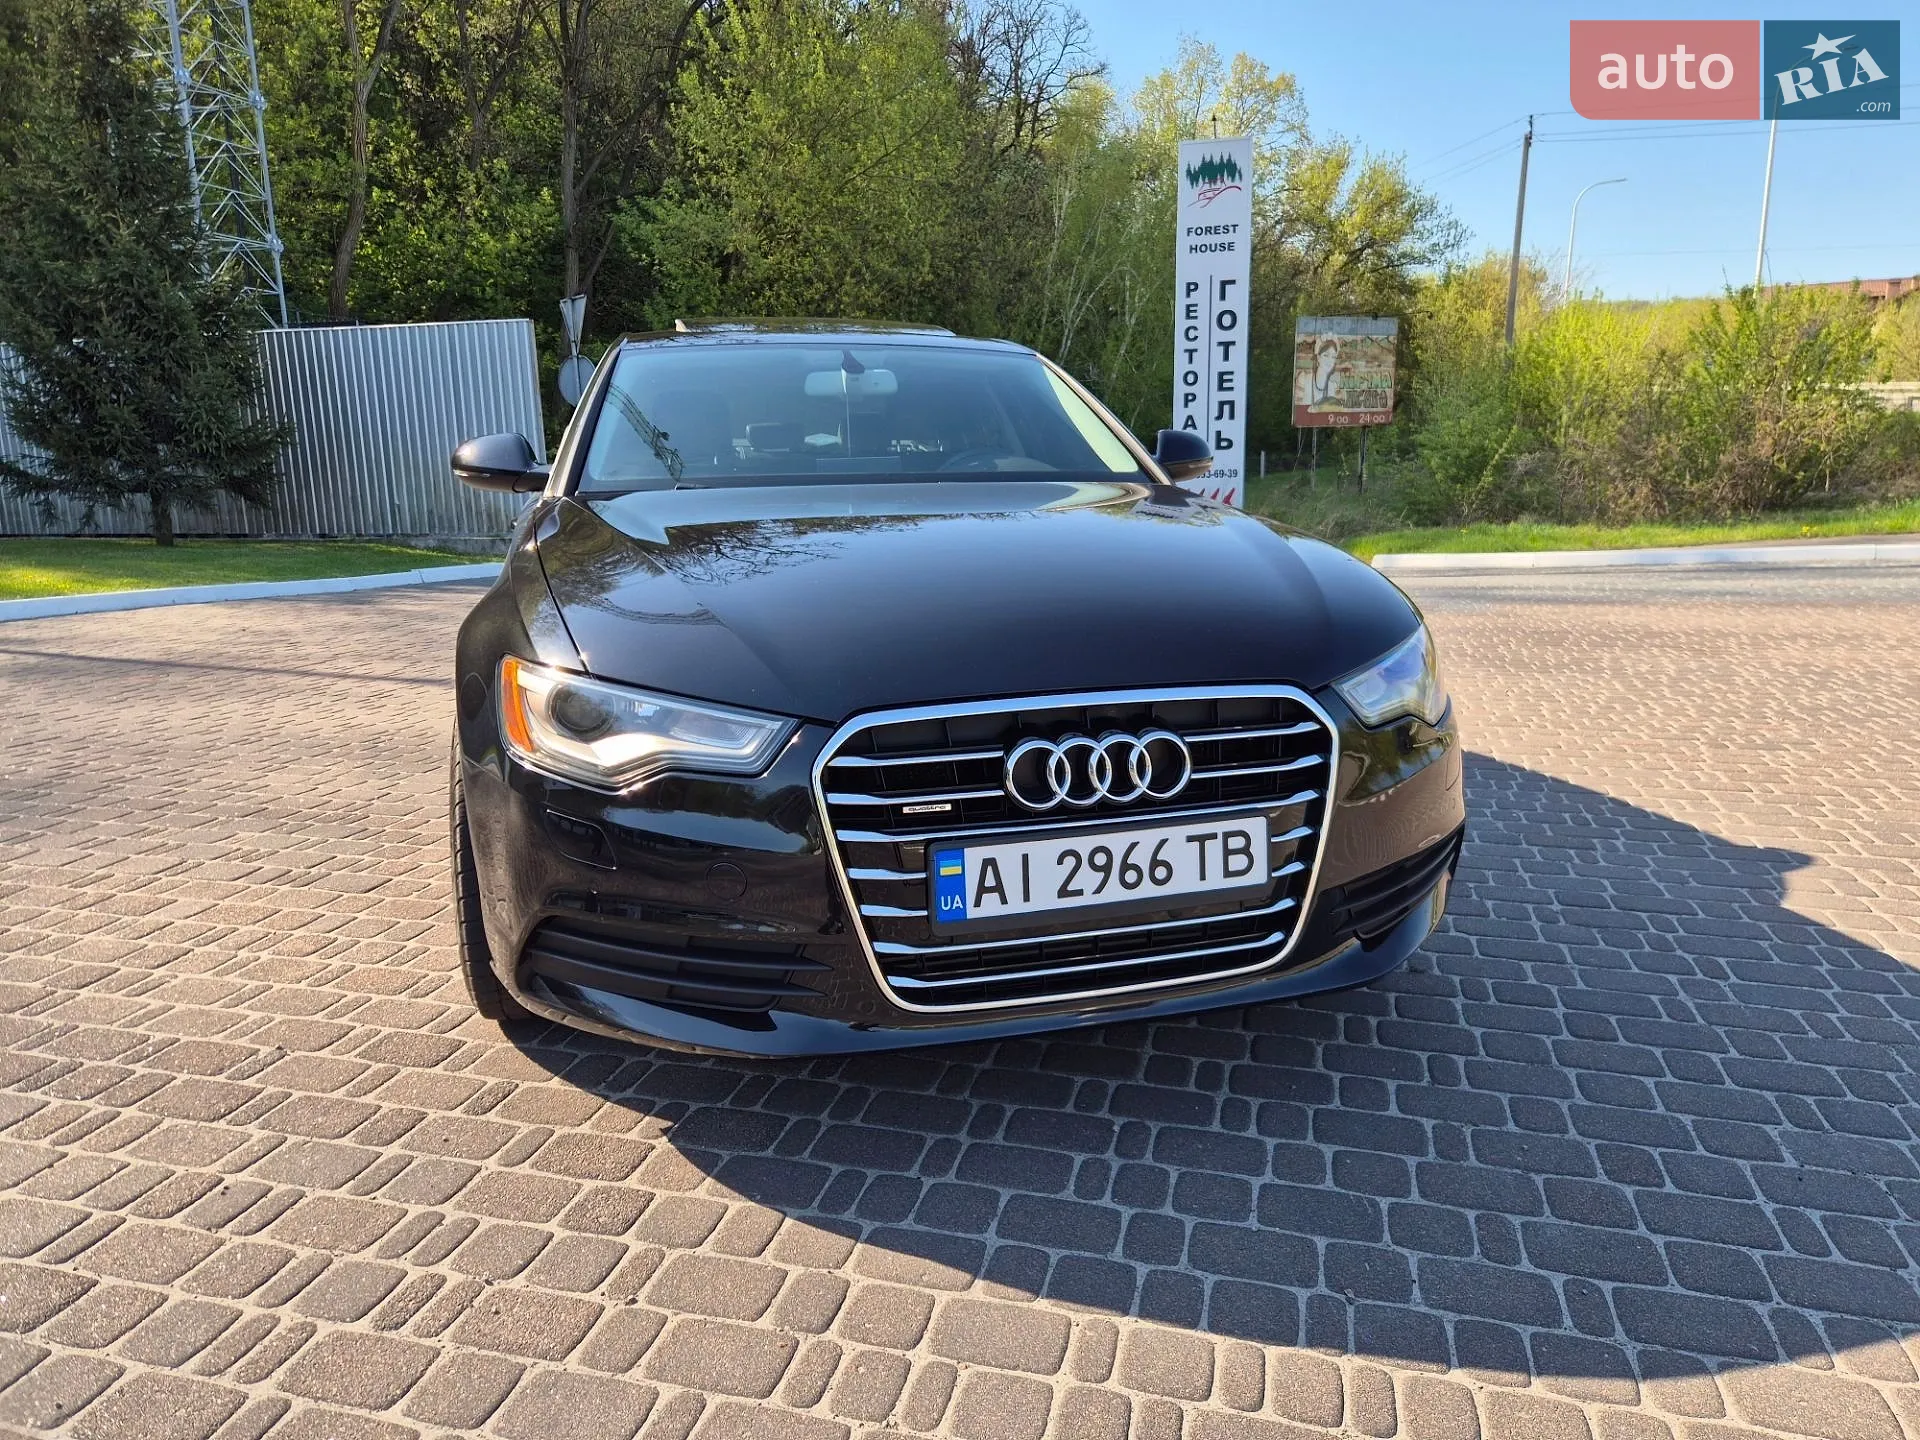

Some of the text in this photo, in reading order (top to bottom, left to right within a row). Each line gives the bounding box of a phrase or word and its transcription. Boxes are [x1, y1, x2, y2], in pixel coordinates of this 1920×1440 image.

[1186, 224, 1239, 237] FOREST
[1189, 241, 1235, 254] HOUSE
[1182, 281, 1199, 431] РЕСТОРА
[1214, 279, 1238, 451] ГОТЕЛЬ
[1197, 468, 1238, 479] 3-69-39
[973, 829, 1255, 908] AI 2966 TB
[941, 894, 964, 910] UA
